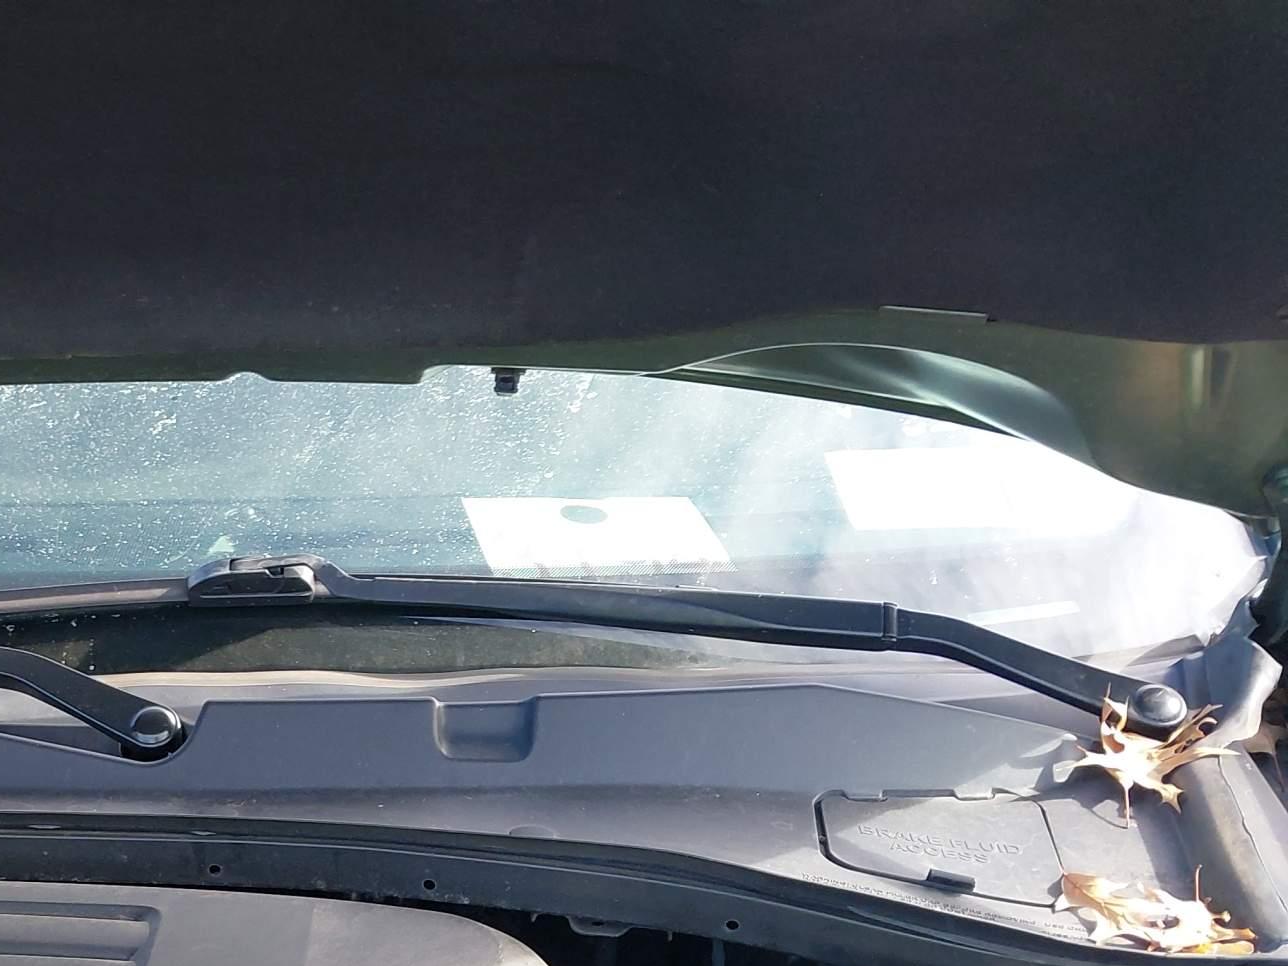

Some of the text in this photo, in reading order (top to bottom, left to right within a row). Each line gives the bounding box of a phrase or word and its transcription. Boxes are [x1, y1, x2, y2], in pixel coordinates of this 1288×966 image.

[857, 823, 1022, 856] BRAKE FLUID
[888, 841, 991, 863] ACCESS
